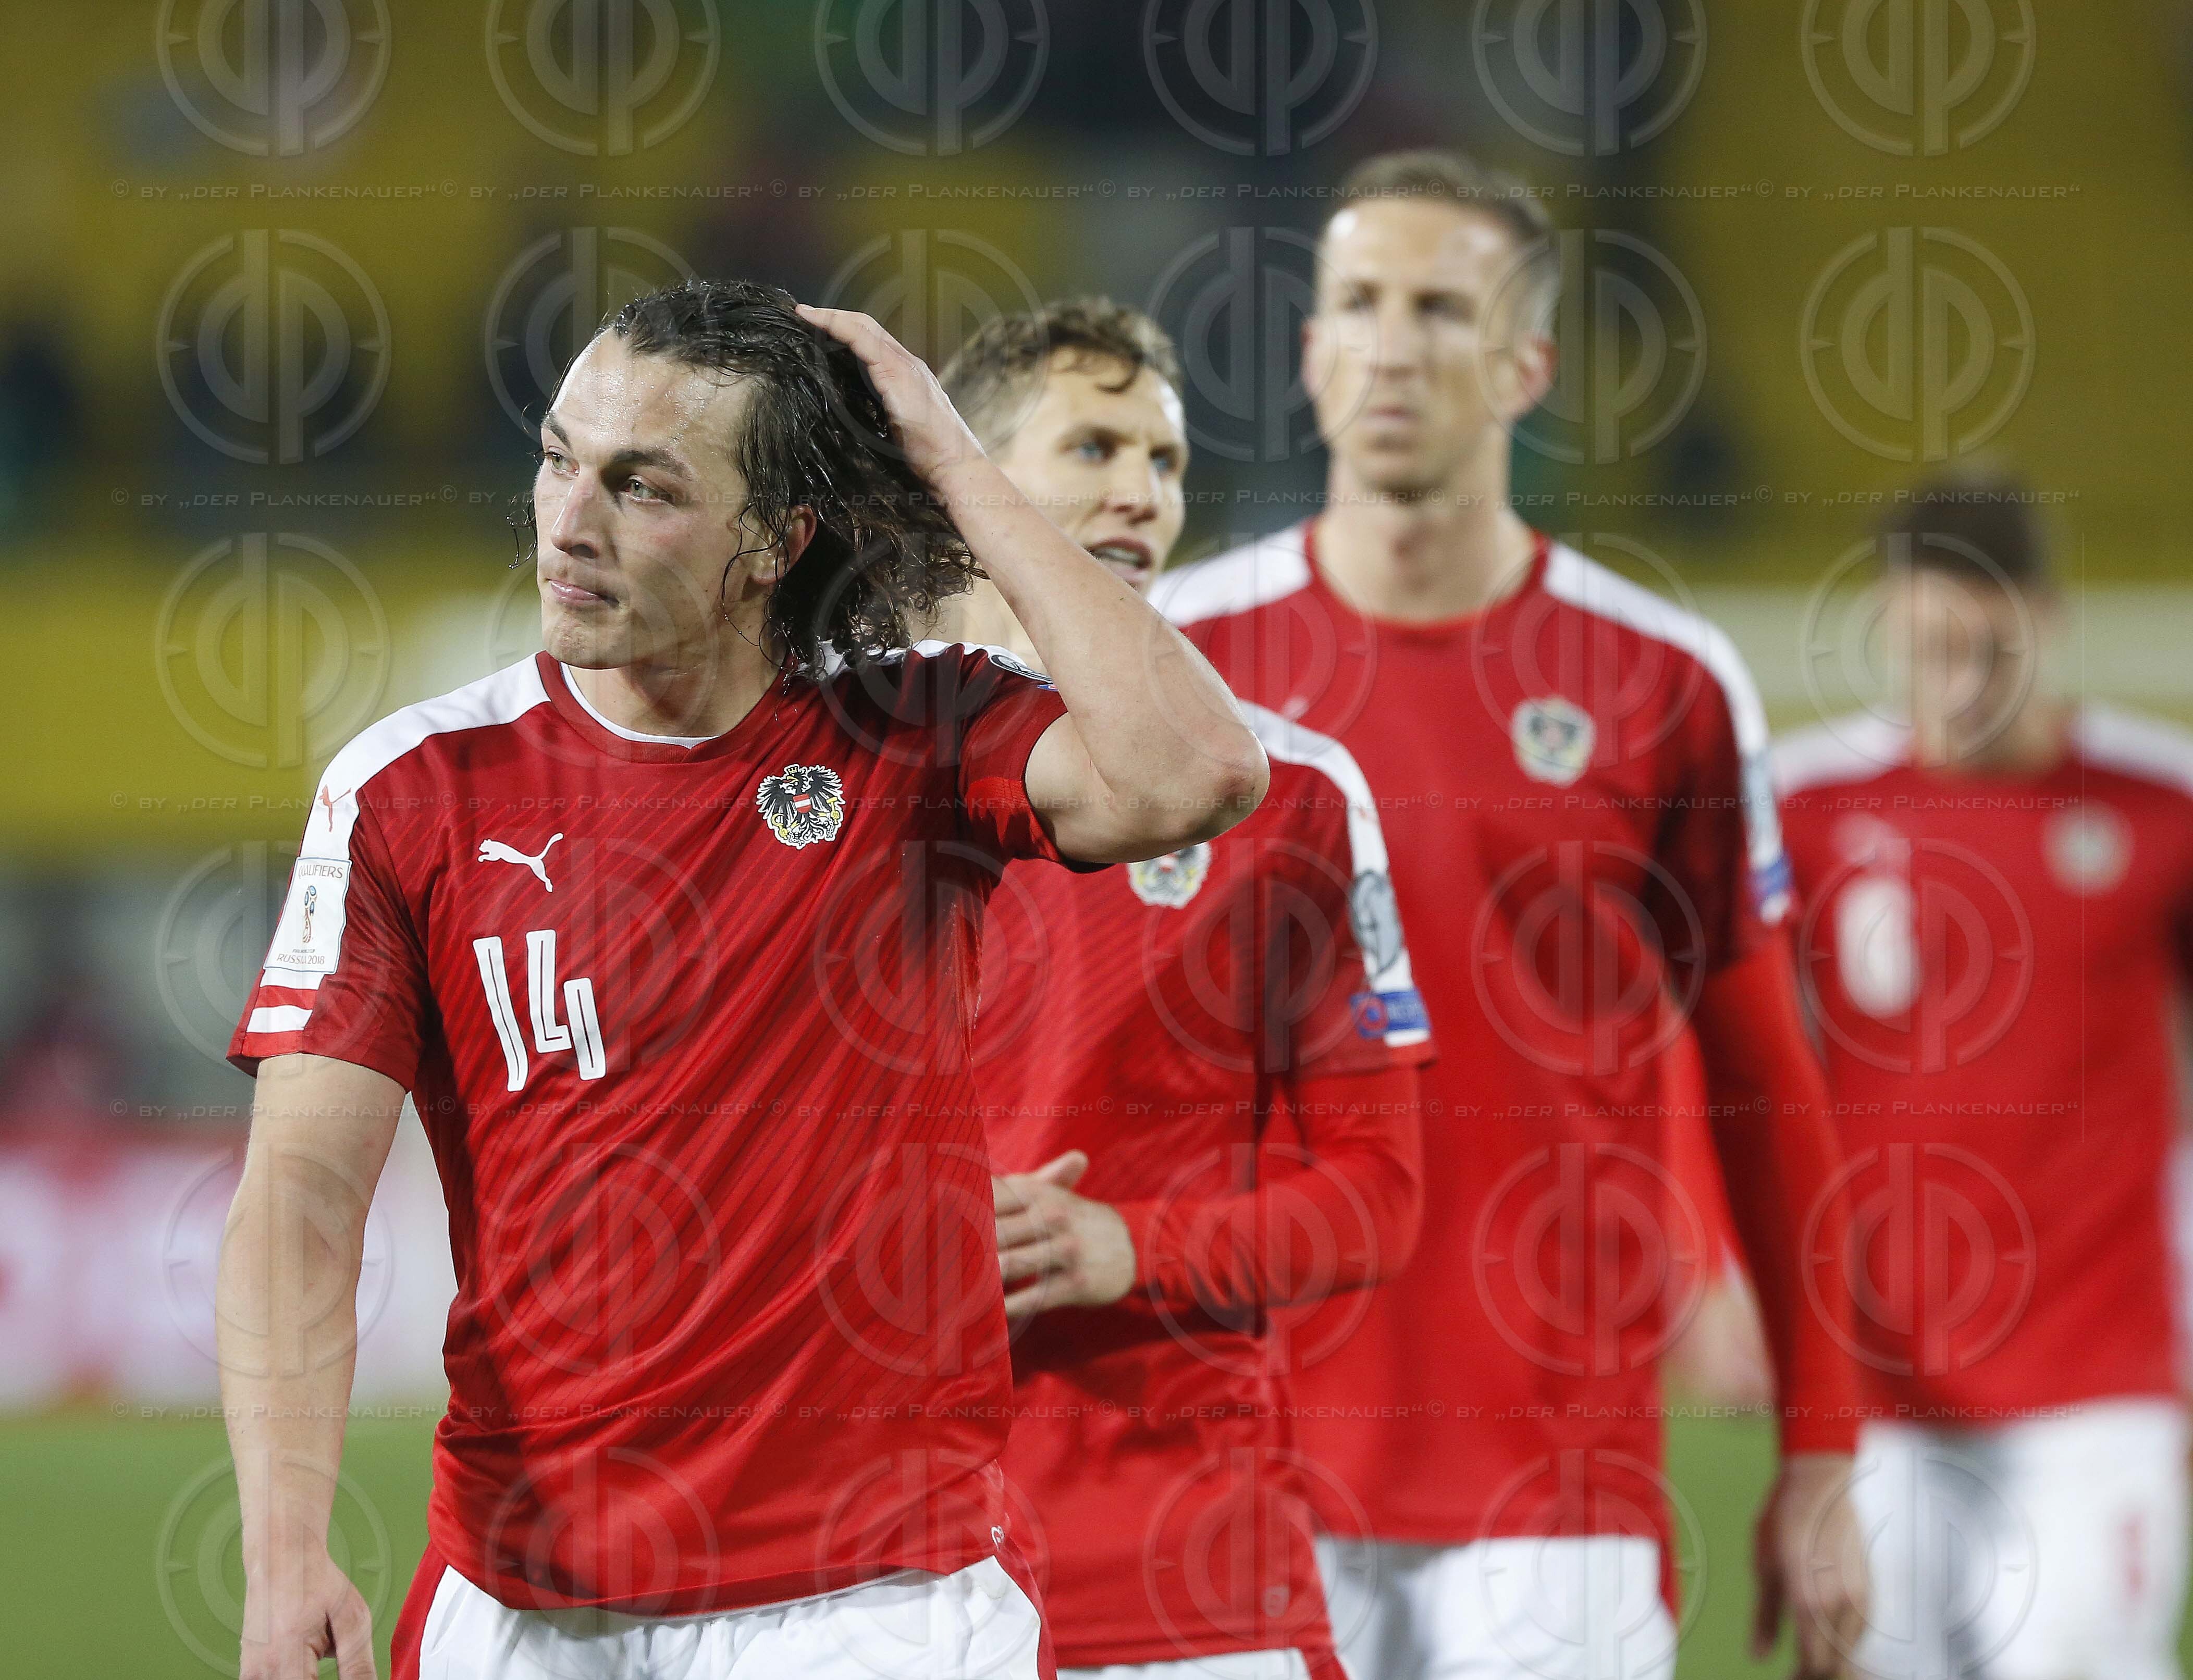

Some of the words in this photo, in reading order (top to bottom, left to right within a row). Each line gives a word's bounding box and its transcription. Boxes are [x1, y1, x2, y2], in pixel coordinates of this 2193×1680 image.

[298, 864, 343, 880] QUALIFIERS
[276, 953, 306, 965] RUSSIA
[307, 955, 325, 965] 2018
[473, 929, 607, 1092] 14
